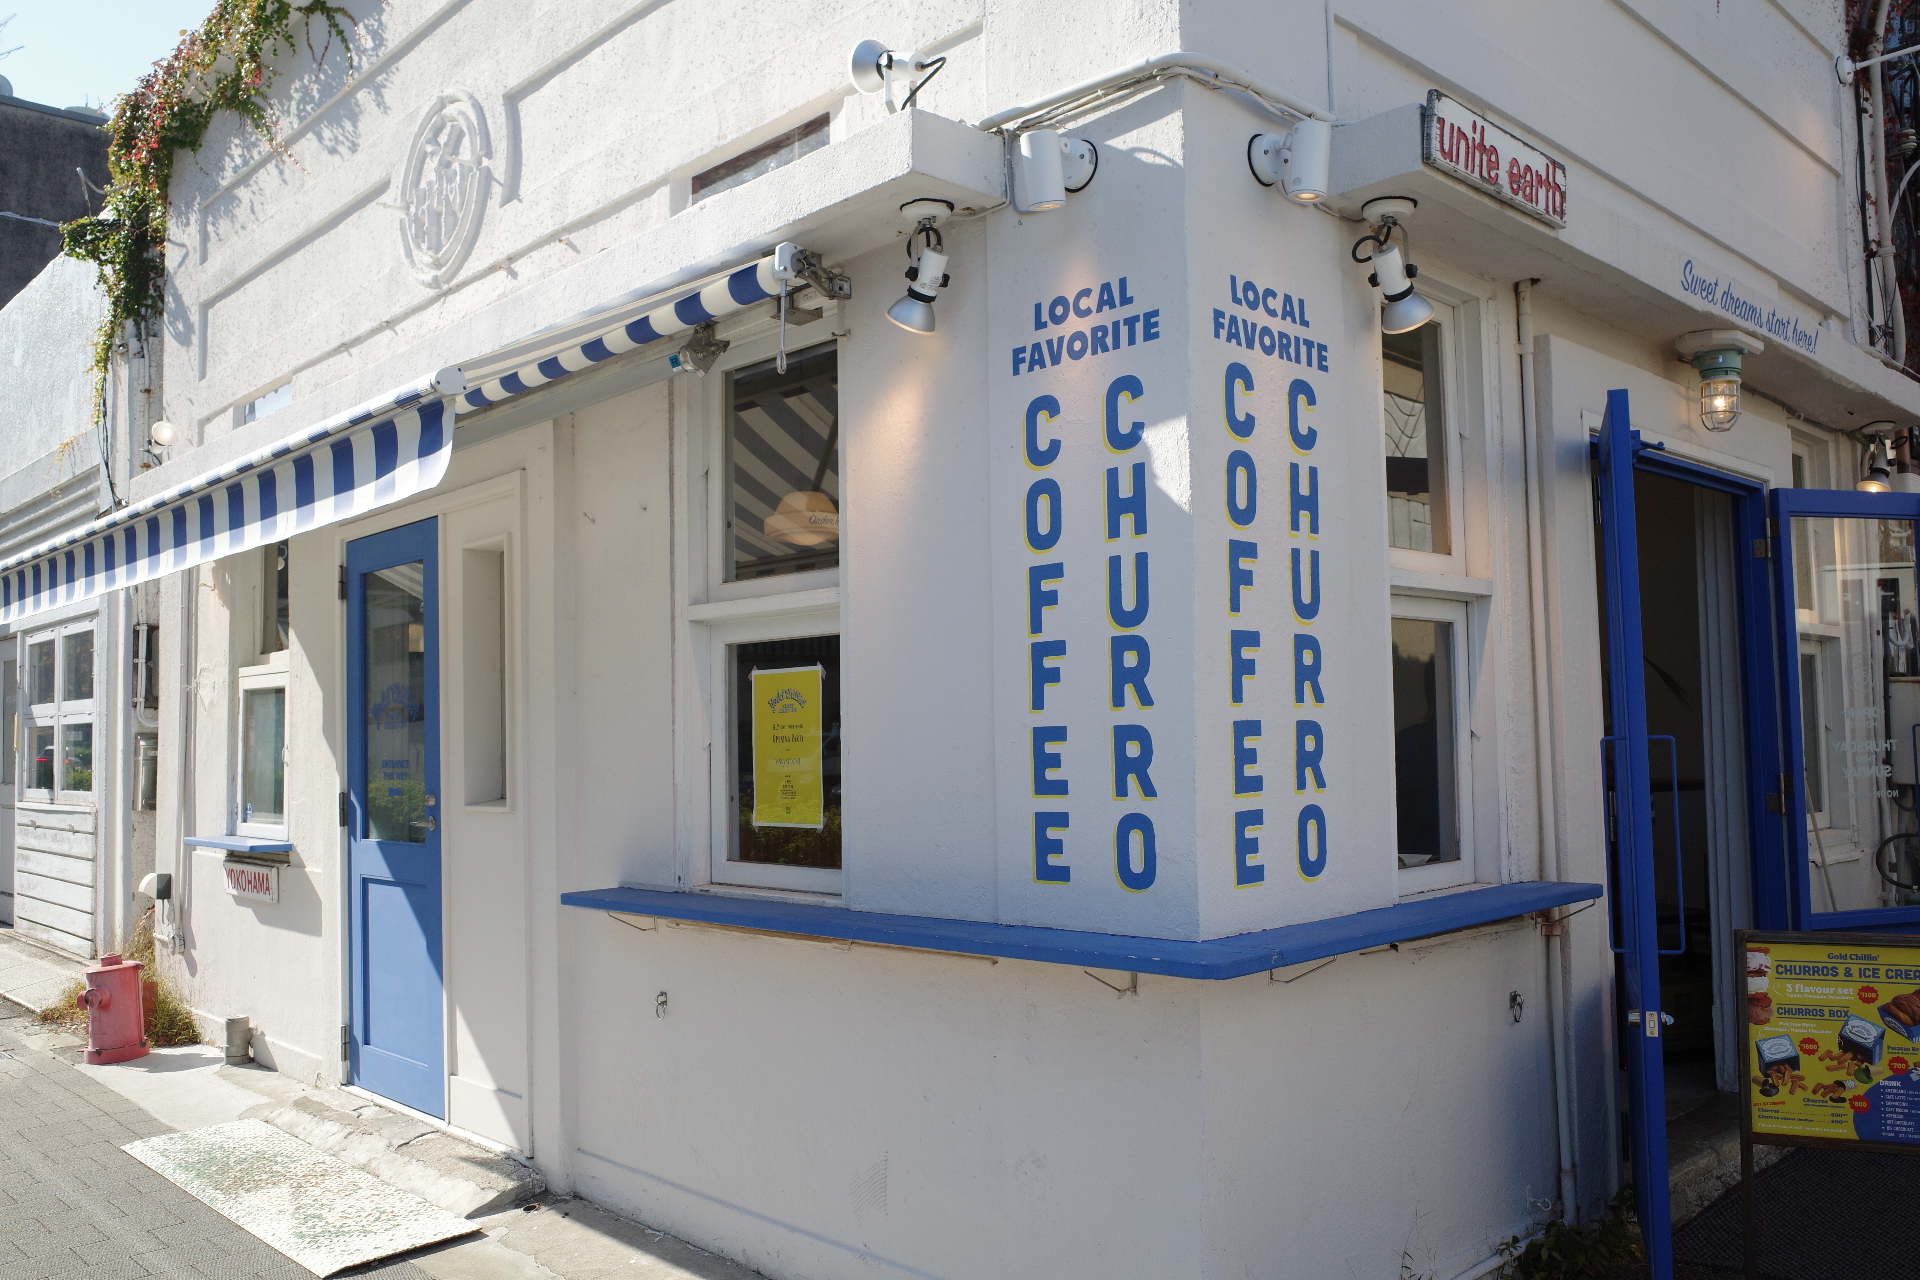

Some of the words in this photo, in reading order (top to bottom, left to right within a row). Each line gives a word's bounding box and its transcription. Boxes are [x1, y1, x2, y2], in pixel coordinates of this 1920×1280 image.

[1439, 117, 1499, 185] unite
[1508, 157, 1564, 220] earth
[1034, 276, 1134, 331] LOCAL
[1230, 274, 1310, 328] LOCAL
[1681, 259, 1718, 306] Sweet
[1720, 282, 1763, 328] dreams
[1765, 308, 1791, 342] start
[1792, 316, 1819, 354] here!
[1012, 308, 1160, 376] FAVORITE
[1213, 307, 1329, 373] FAVORITE
[1022, 394, 1071, 885] COFFEE
[1102, 374, 1157, 893] CHURRO
[1223, 362, 1265, 889] COFFEE
[1287, 378, 1328, 882] CHURRO
[225, 868, 270, 896] YOKOHAMA
[1775, 964, 1840, 978] CHURROS
[1844, 967, 1854, 978] &
[1858, 967, 1880, 979] ICE
[1827, 952, 1848, 960] Gold
[1776, 1006, 1825, 1018] CHURROS
[1828, 1008, 1850, 1019] BOX
[1786, 984, 1794, 993] 3
[1795, 984, 1835, 994] flavour
[1837, 986, 1854, 995] set
